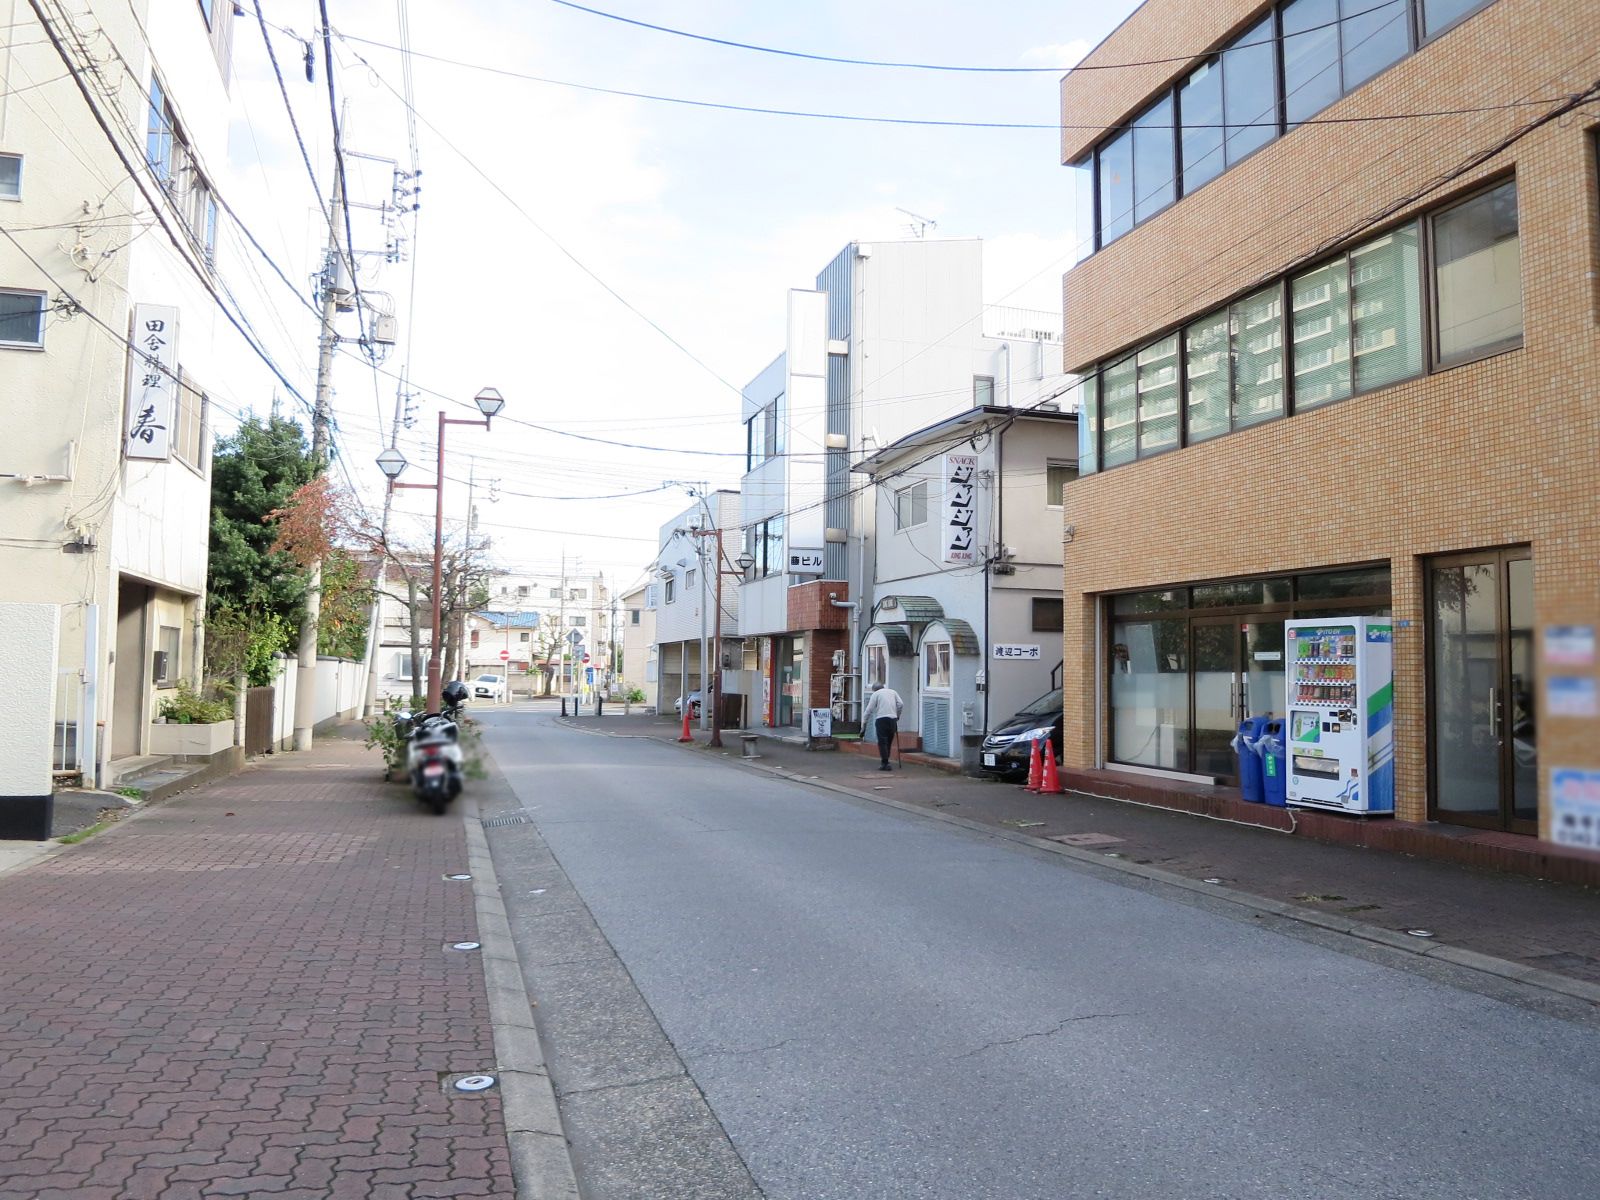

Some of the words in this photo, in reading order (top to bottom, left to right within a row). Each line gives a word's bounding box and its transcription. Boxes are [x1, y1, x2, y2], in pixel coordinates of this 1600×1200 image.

[142, 320, 166, 388] 田舎料理
[130, 403, 167, 444] 春
[949, 456, 975, 466] SNACK
